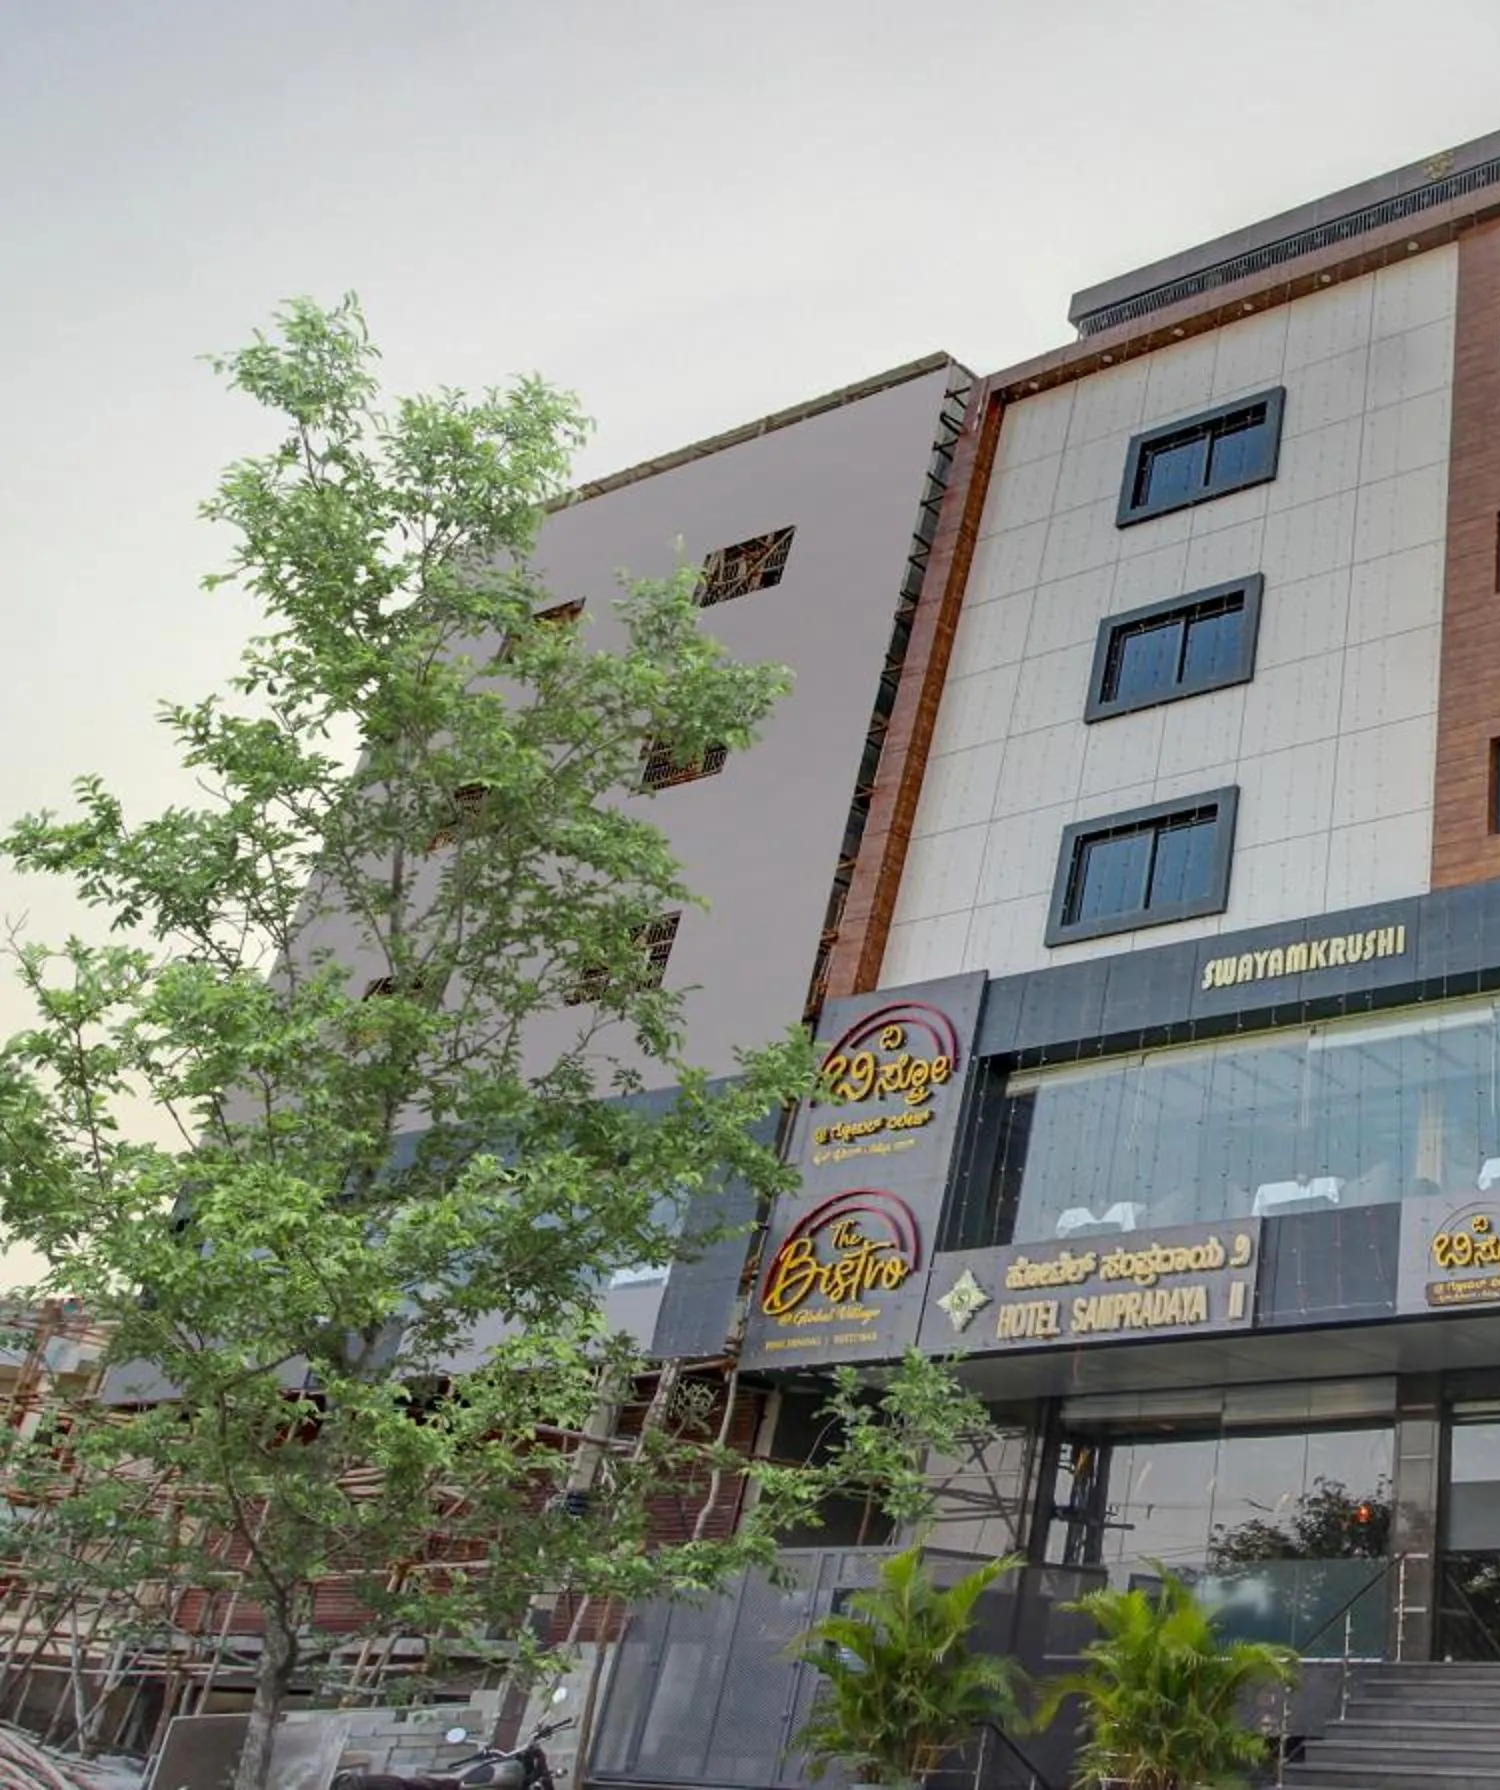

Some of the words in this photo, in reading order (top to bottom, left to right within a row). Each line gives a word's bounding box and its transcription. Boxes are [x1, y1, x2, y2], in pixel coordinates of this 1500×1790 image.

[1202, 925, 1406, 990] SWAYAMKRUSHI
[831, 1219, 859, 1249] The
[763, 1239, 909, 1315] Bistro
[997, 1299, 1061, 1339] HOTEL
[1071, 1286, 1207, 1334] SAMPRADAYA
